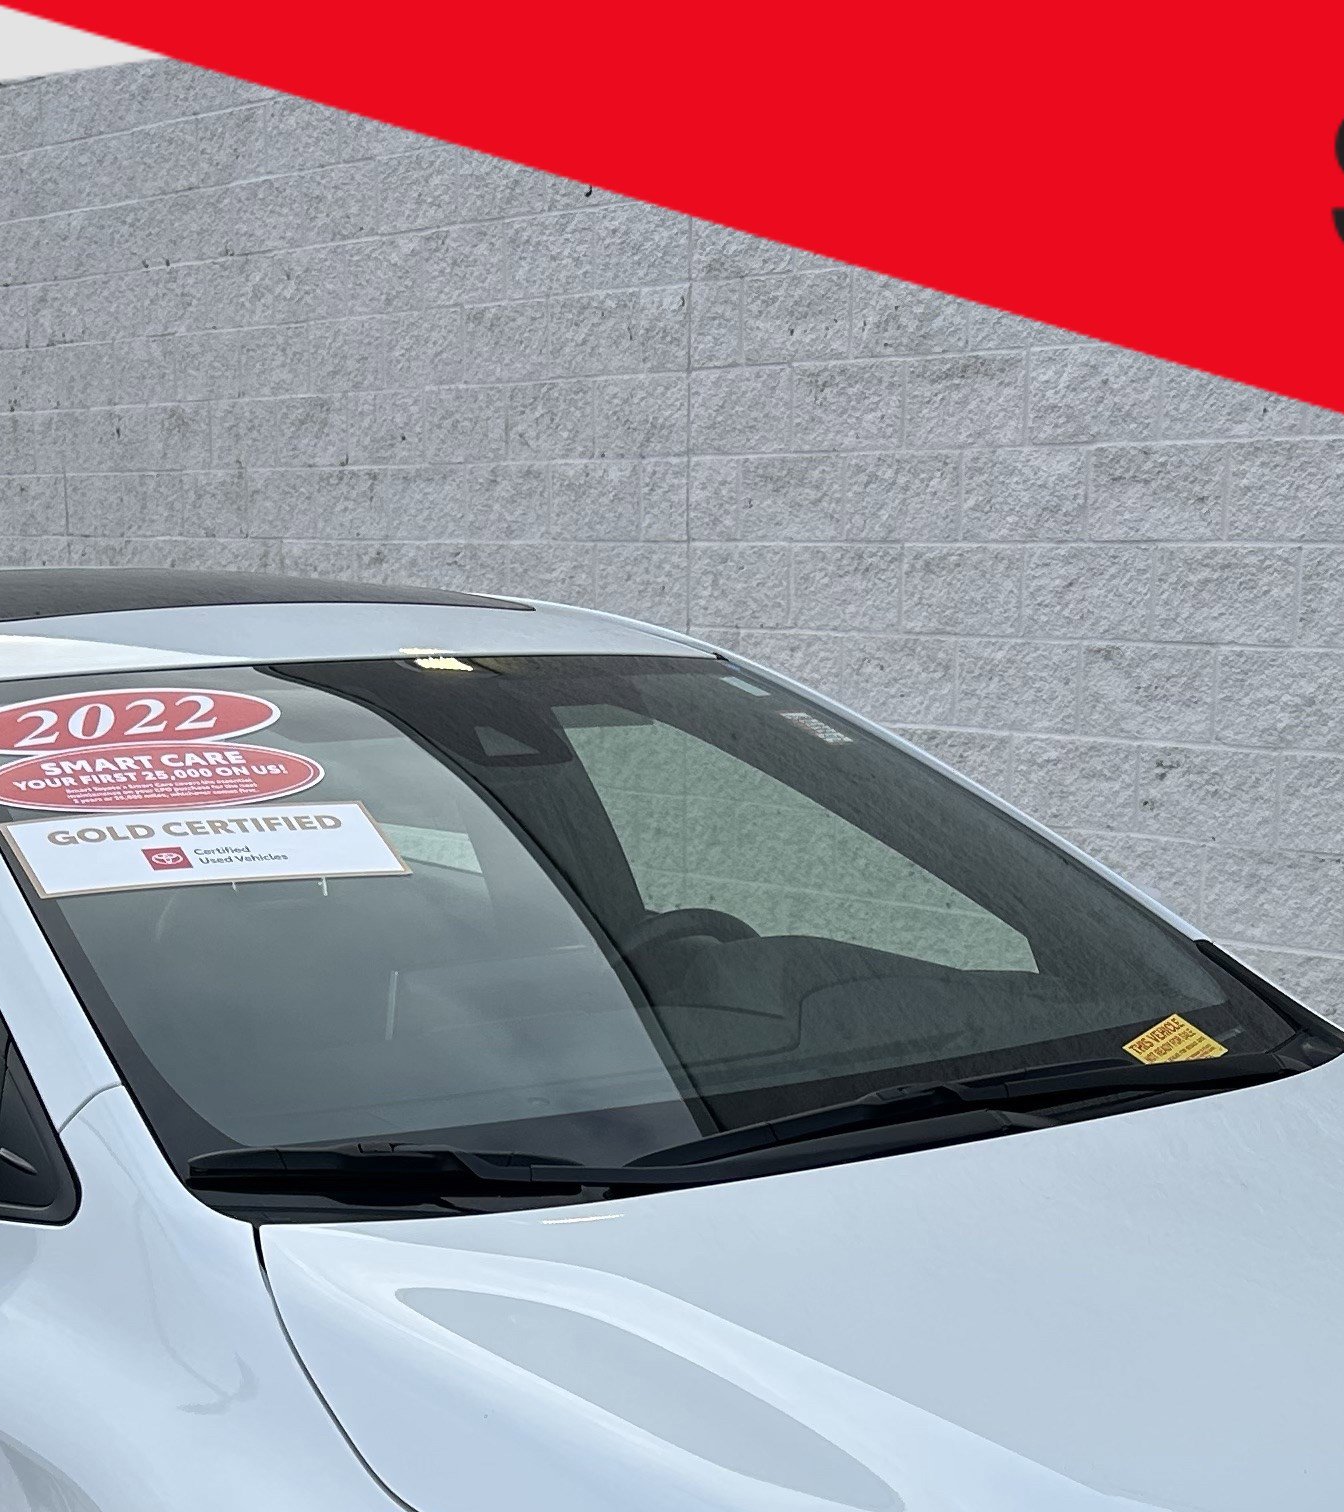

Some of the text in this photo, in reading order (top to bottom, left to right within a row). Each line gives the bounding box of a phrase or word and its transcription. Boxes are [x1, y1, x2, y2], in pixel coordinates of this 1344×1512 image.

[14, 694, 218, 748] 2022
[40, 750, 246, 776] SMART CARE
[12, 764, 288, 791] YOUR FIRST 25,000 ON US!
[47, 814, 342, 846] GOLD CERTIFIED
[193, 845, 251, 856] Certified
[198, 853, 289, 865] Used Vehicles
